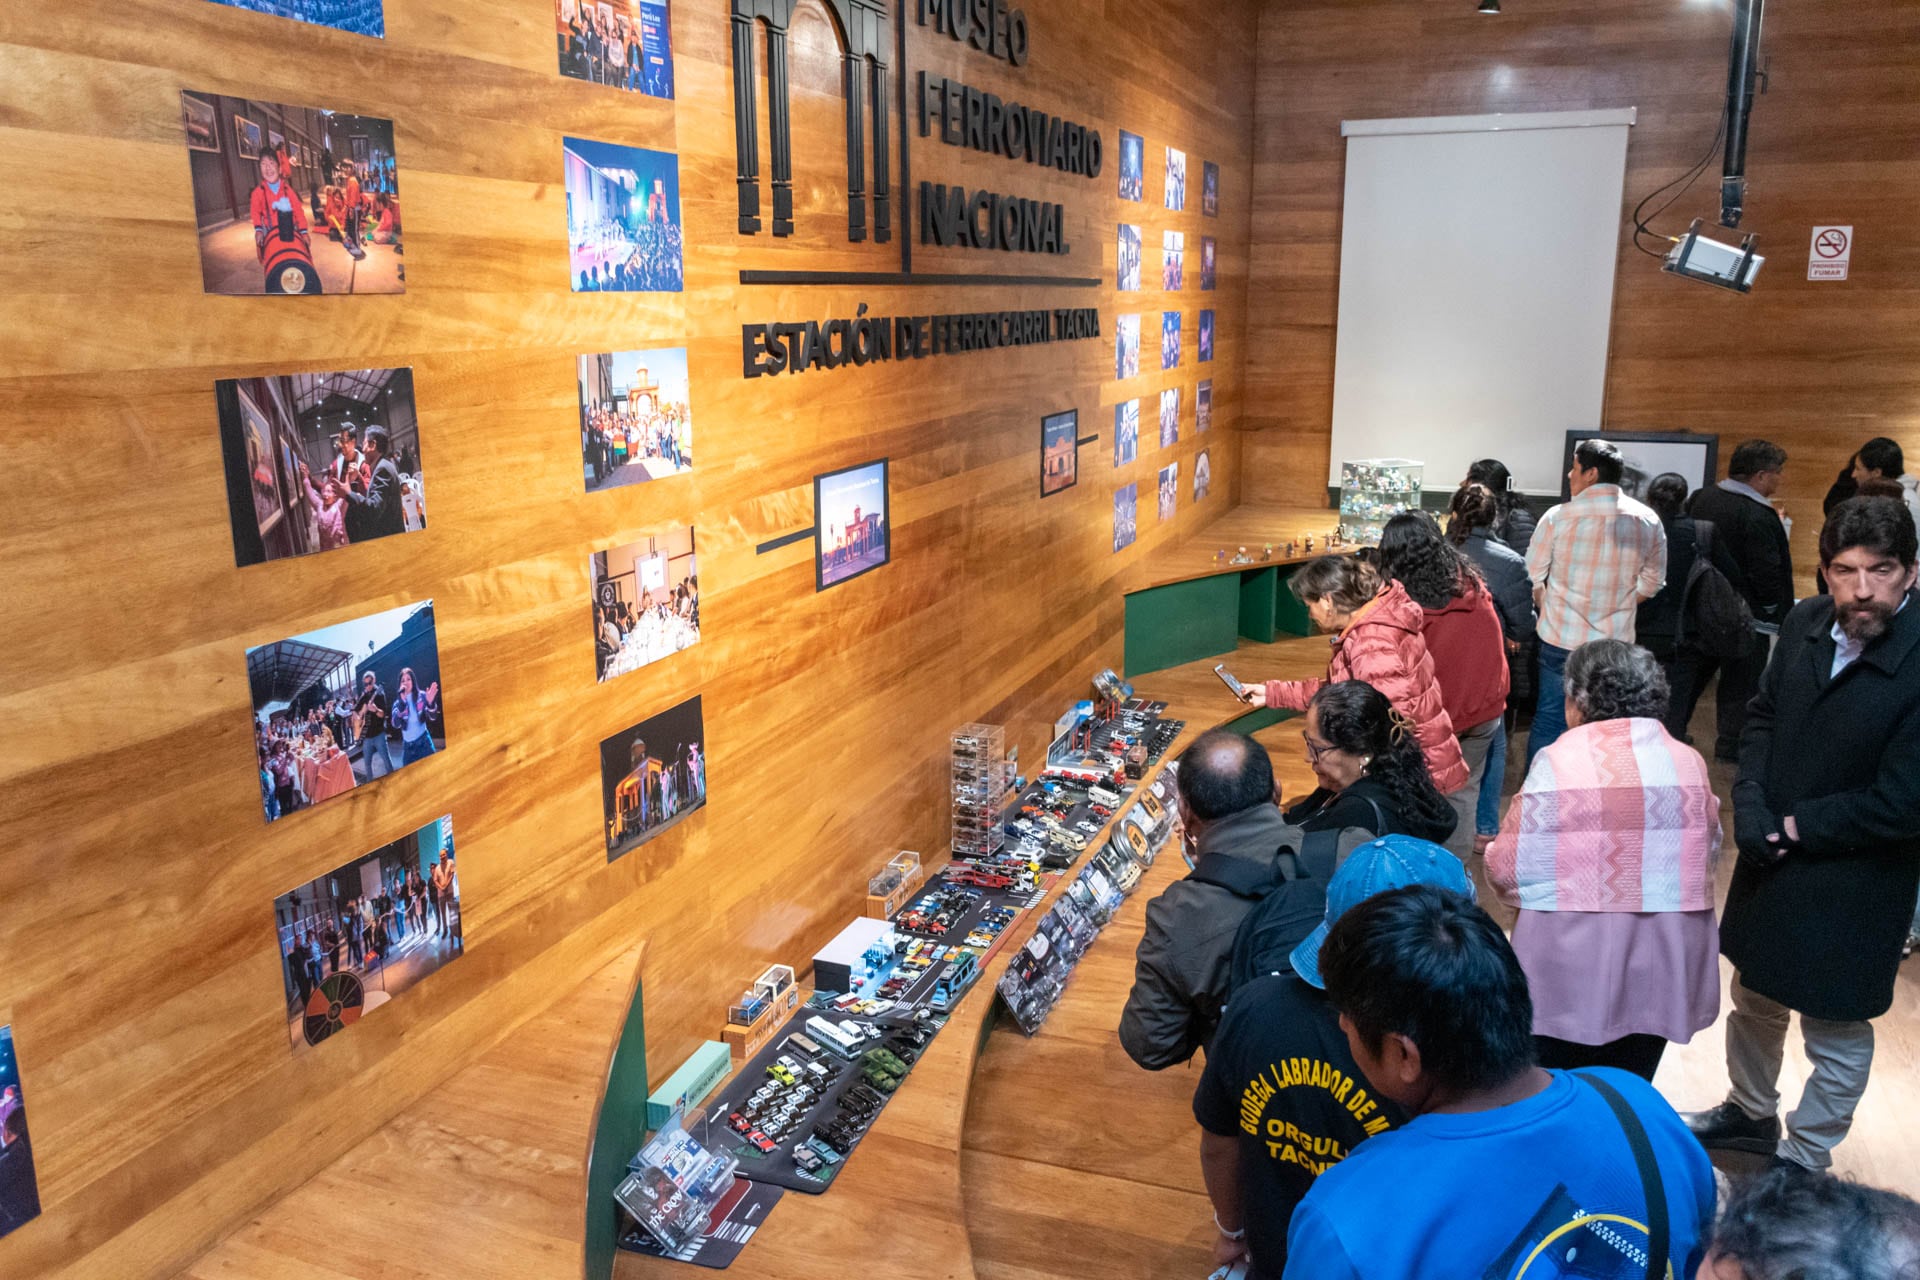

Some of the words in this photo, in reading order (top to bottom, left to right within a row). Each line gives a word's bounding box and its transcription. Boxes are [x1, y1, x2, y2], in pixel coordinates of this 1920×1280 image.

[919, 70, 1102, 178] FERROVIARIO
[920, 181, 1070, 255] NACIONAL
[742, 303, 891, 379] ESTACIÓN
[895, 316, 931, 361] DE
[932, 310, 1056, 354] FERROCARRIL
[1057, 308, 1100, 339] TACNA
[1240, 1073, 1276, 1135] BODEGA
[1270, 1057, 1354, 1103] LABRADOR
[1346, 1088, 1377, 1121] DE
[1363, 1115, 1390, 1137] M
